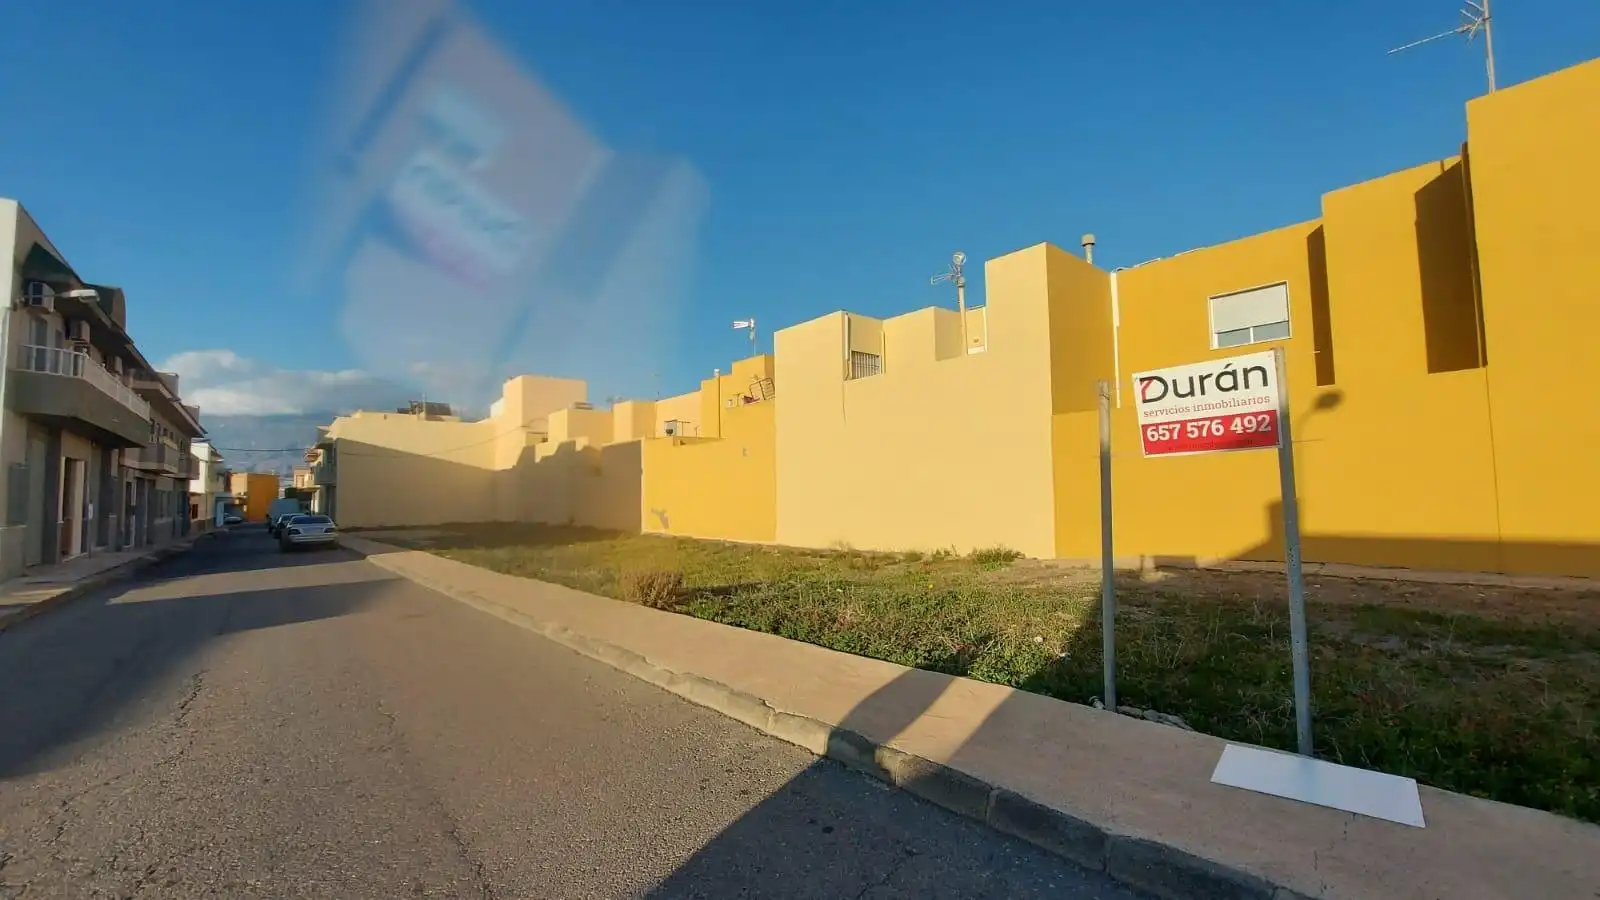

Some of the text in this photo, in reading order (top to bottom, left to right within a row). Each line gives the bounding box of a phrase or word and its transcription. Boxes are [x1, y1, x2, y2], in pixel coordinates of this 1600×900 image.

[1139, 363, 1268, 404] Durán
[1143, 395, 1270, 417] servicios inmobiliarios
[1146, 414, 1271, 442] 657 576 492
